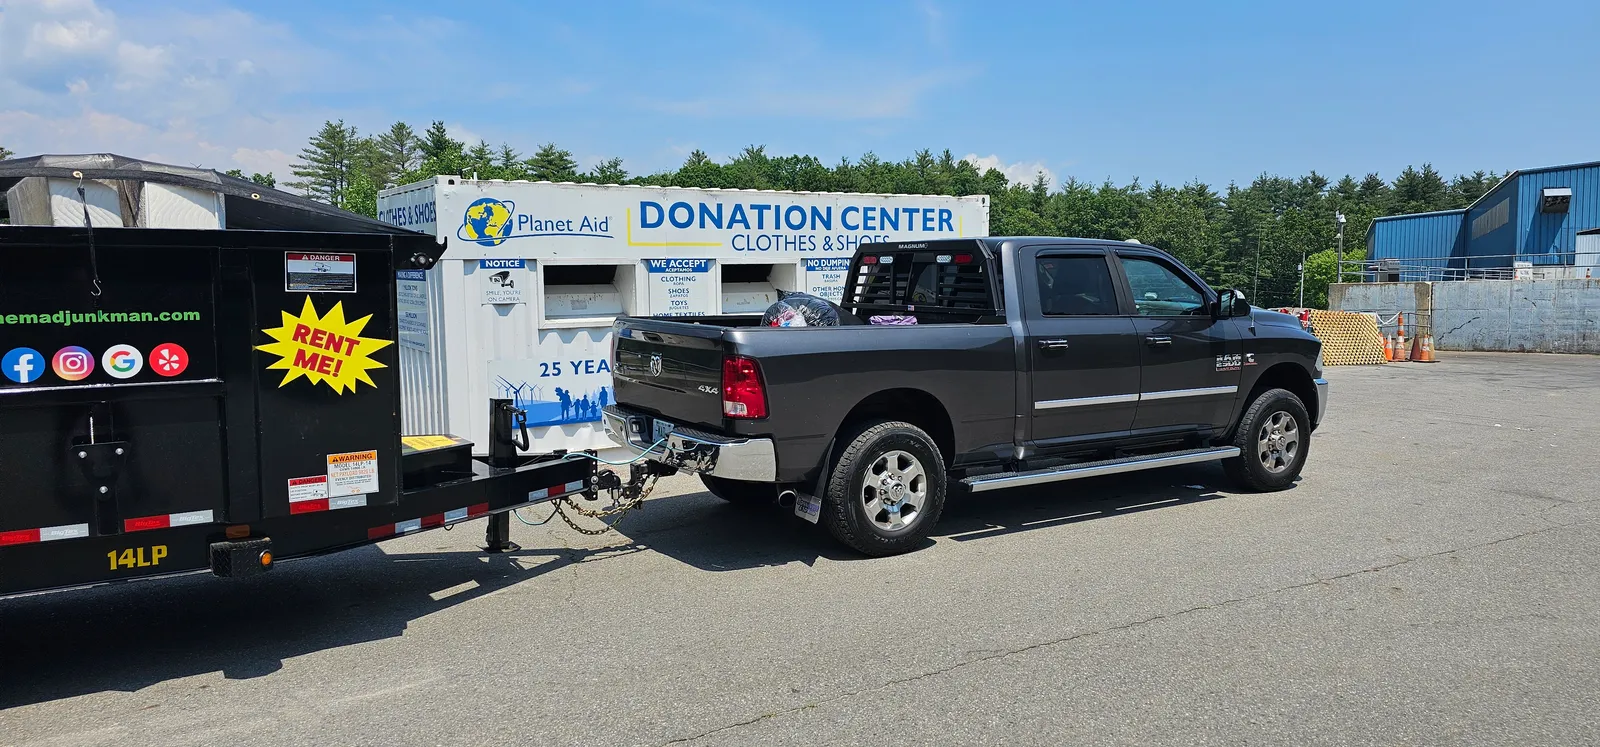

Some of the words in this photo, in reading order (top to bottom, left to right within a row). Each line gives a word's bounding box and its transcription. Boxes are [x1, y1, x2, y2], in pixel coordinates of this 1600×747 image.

[408, 206, 413, 226] &
[415, 201, 436, 224] SHOES
[640, 201, 832, 231] DONATION
[841, 205, 954, 232] CENTER
[518, 214, 573, 231] Planet
[732, 234, 816, 251] CLOTHES
[822, 235, 834, 251] &
[485, 260, 520, 268] NOTICE
[650, 259, 667, 268] WE
[669, 259, 707, 268] ACCEPT
[807, 259, 819, 267] NO
[820, 258, 850, 267] DUMPIN
[292, 323, 361, 357] RENT
[292, 348, 343, 378] ME!
[539, 362, 562, 377] 25
[569, 359, 611, 375] YEA
[338, 453, 372, 462] WARNING
[50, 529, 80, 537] BigTex
[107, 545, 168, 571] 14LP
